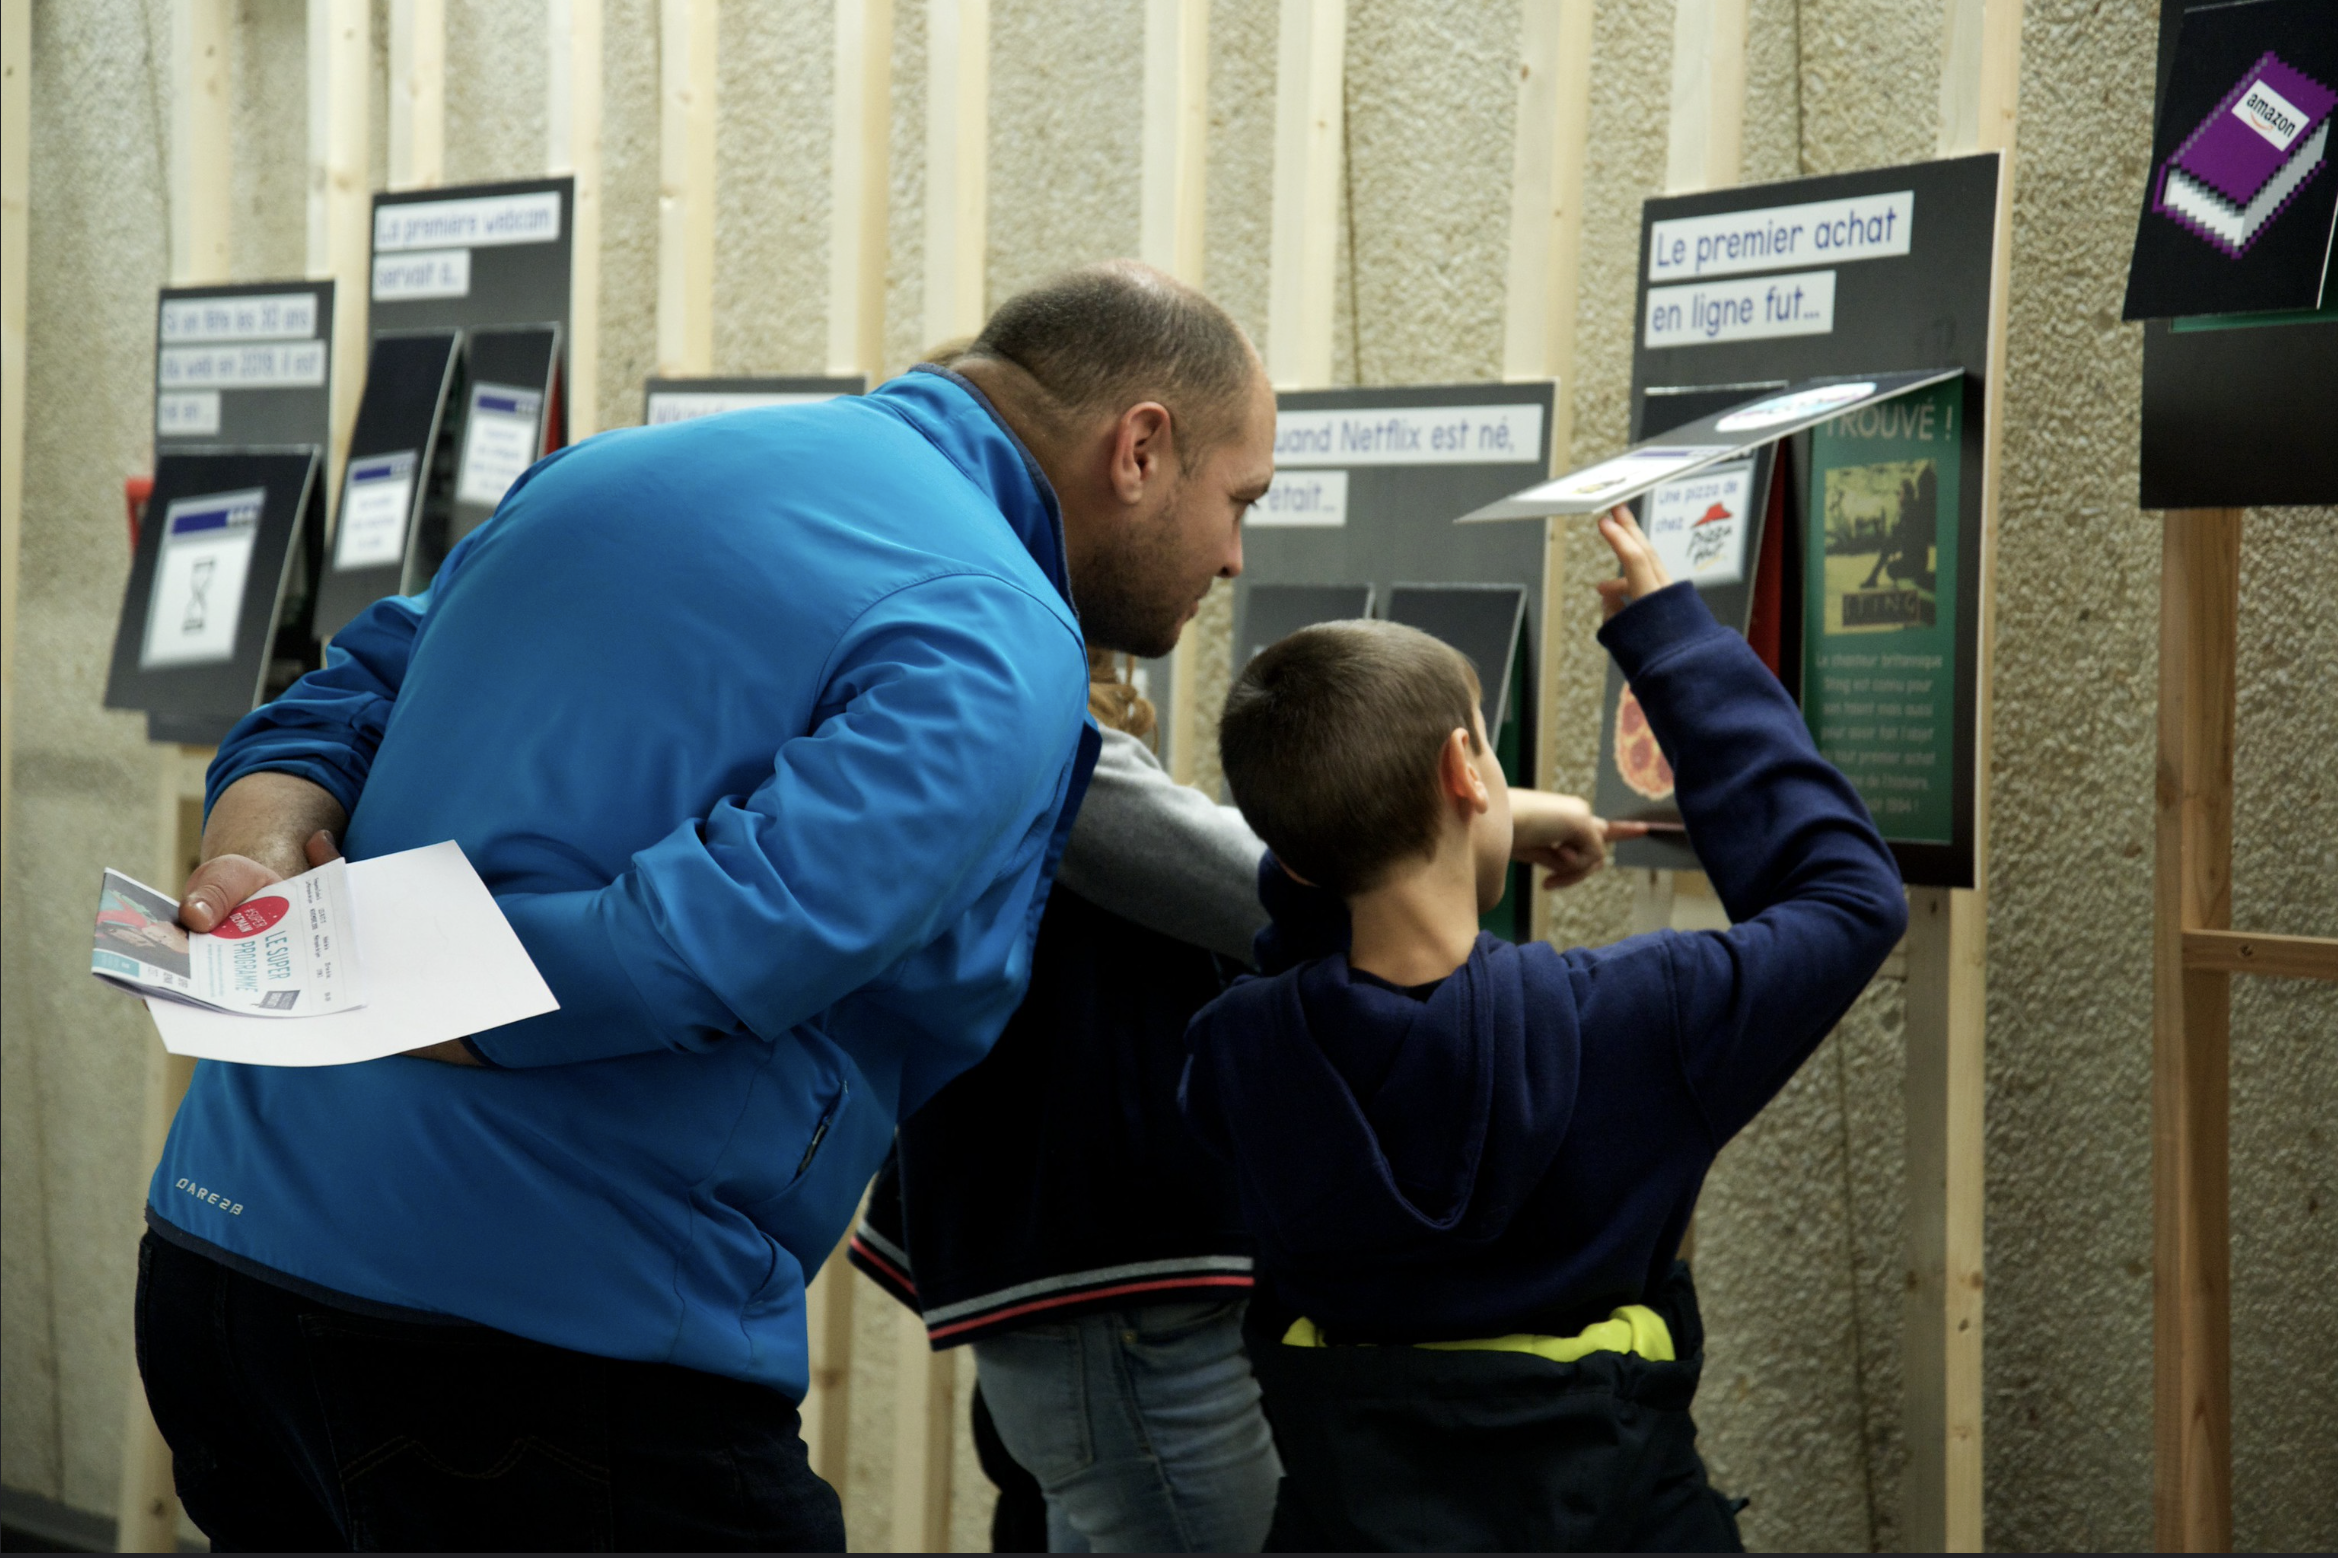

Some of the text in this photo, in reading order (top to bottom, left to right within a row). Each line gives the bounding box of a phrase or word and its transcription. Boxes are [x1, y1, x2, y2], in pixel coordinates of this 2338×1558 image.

[2246, 93, 2296, 138] amazon
[485, 205, 550, 232] webcam
[1657, 207, 1896, 272] Le premier achat
[1652, 285, 1821, 337] en ligne fut...
[1274, 416, 1515, 453] uand Netflix est né,
[1267, 482, 1338, 513] était...
[1684, 483, 1720, 505] pizza
[264, 930, 288, 948] LE
[233, 940, 258, 993] PROGRAMME
[266, 946, 292, 980] SUPER
[175, 1178, 244, 1216] DARE2B
